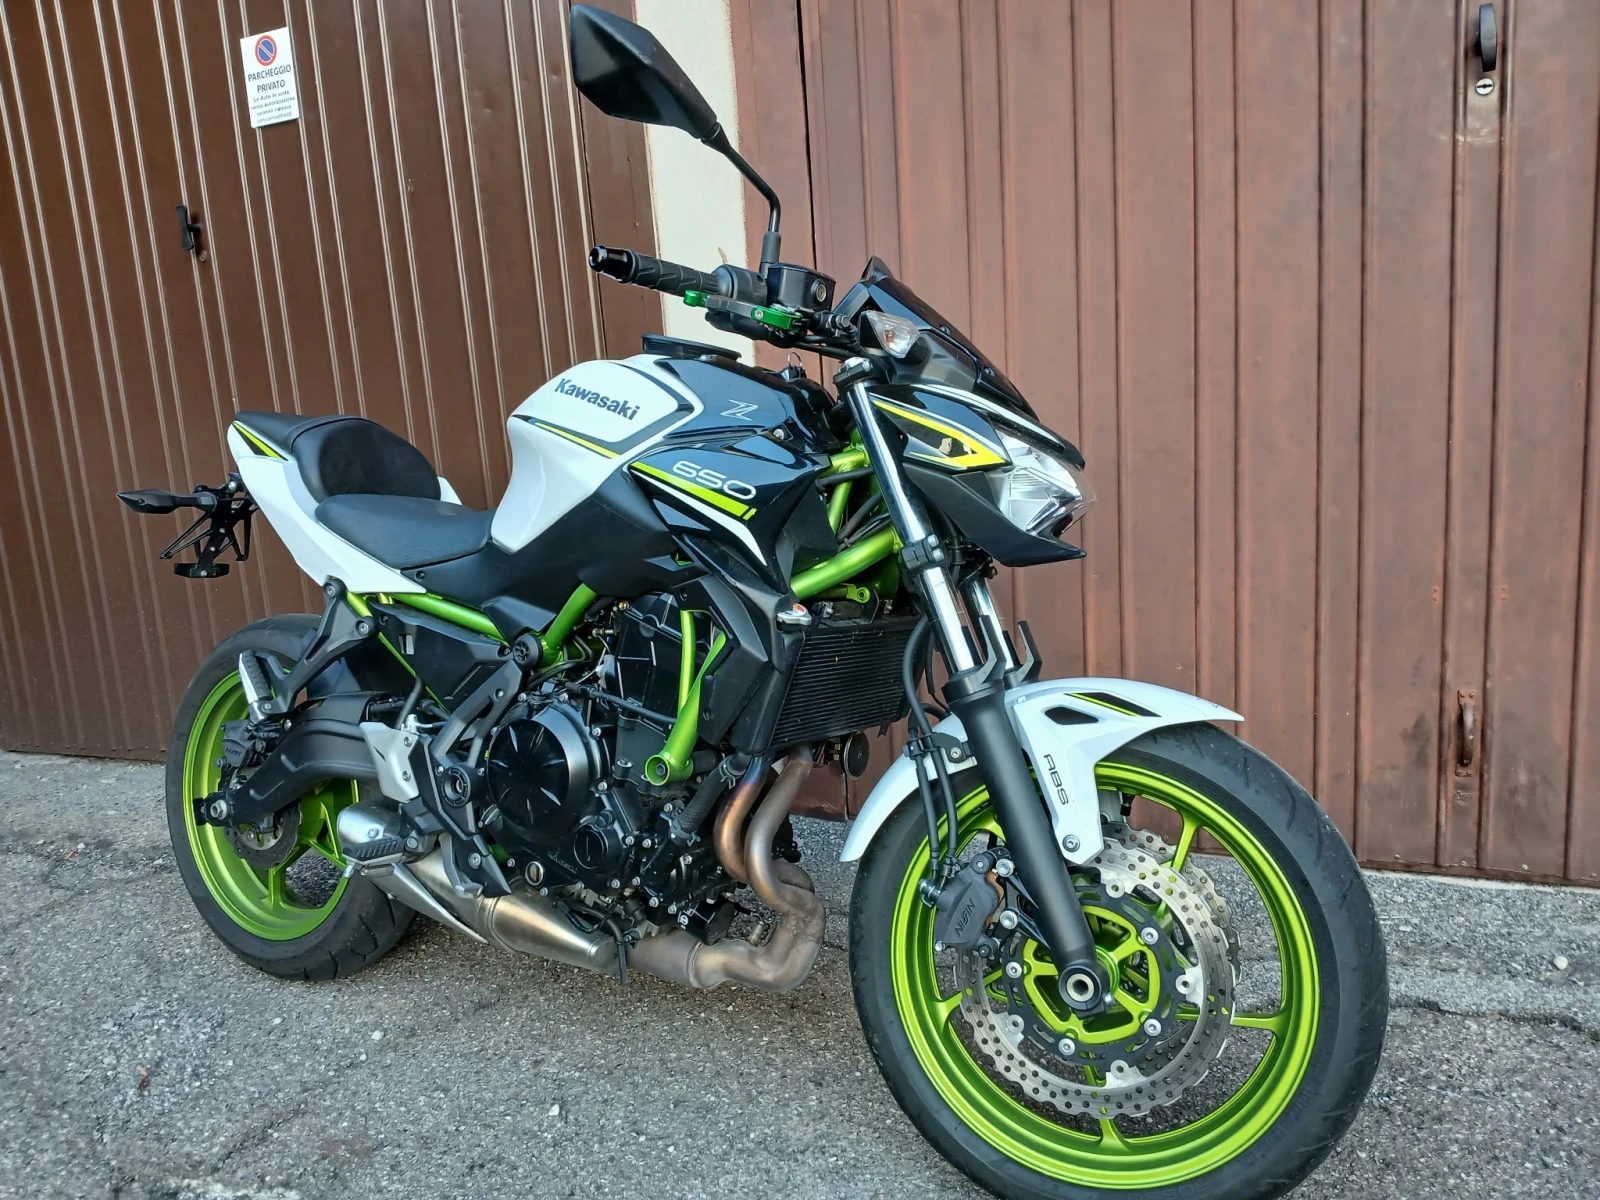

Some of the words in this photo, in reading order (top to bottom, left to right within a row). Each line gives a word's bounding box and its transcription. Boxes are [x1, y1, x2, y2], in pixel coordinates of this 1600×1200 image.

[248, 64, 291, 82] PARCHEGGIO
[257, 79, 285, 93] PRIVATO
[554, 378, 640, 421] Kawasaki
[672, 460, 757, 500] 650
[1043, 753, 1069, 805] ABS
